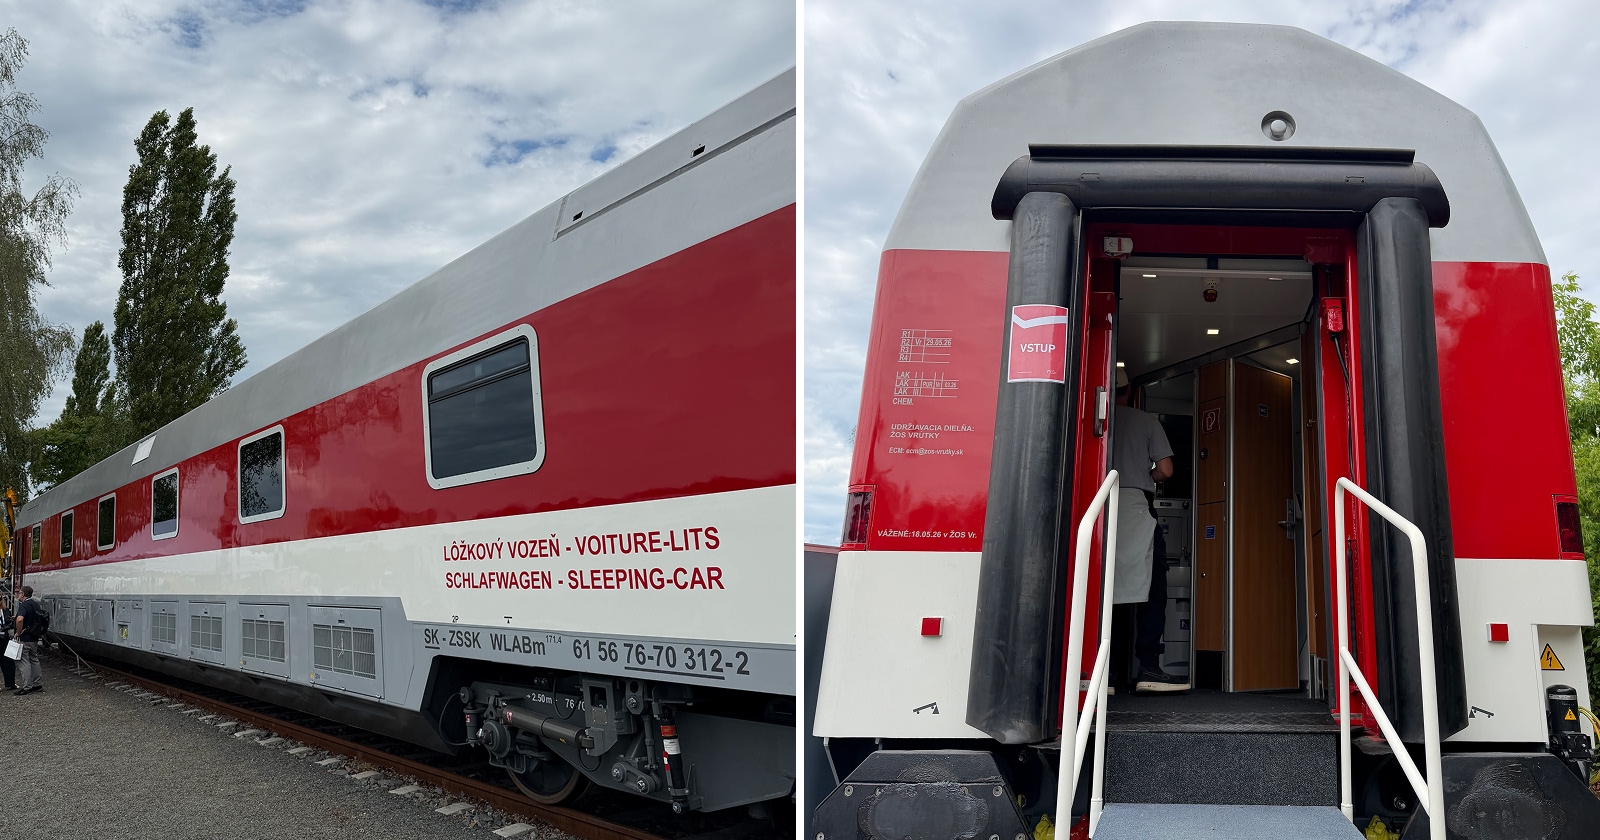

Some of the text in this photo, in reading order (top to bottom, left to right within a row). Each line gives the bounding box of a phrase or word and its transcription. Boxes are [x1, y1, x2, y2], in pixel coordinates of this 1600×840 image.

[1020, 343, 1056, 353] VSTUP
[892, 397, 914, 405] CHEM.
[891, 422, 942, 431] UDRŽIAVACIA
[889, 430, 940, 439] ŽOS VRÚTKY
[949, 530, 966, 539] ŽOS
[443, 537, 504, 561] LÔŽKOVÝ
[507, 533, 561, 559] VOZEŇ
[574, 526, 721, 556] VOITURE-LITS
[445, 570, 552, 590] SCHLAFWAGEN
[567, 566, 726, 591] SLEEPING-CAR
[424, 628, 440, 645] SK
[448, 629, 482, 649] ZSSK
[572, 638, 591, 660] 61
[597, 640, 619, 663] 56
[623, 642, 677, 669] 76-70
[683, 646, 750, 676] 312-2
[564, 698, 575, 709] 76
